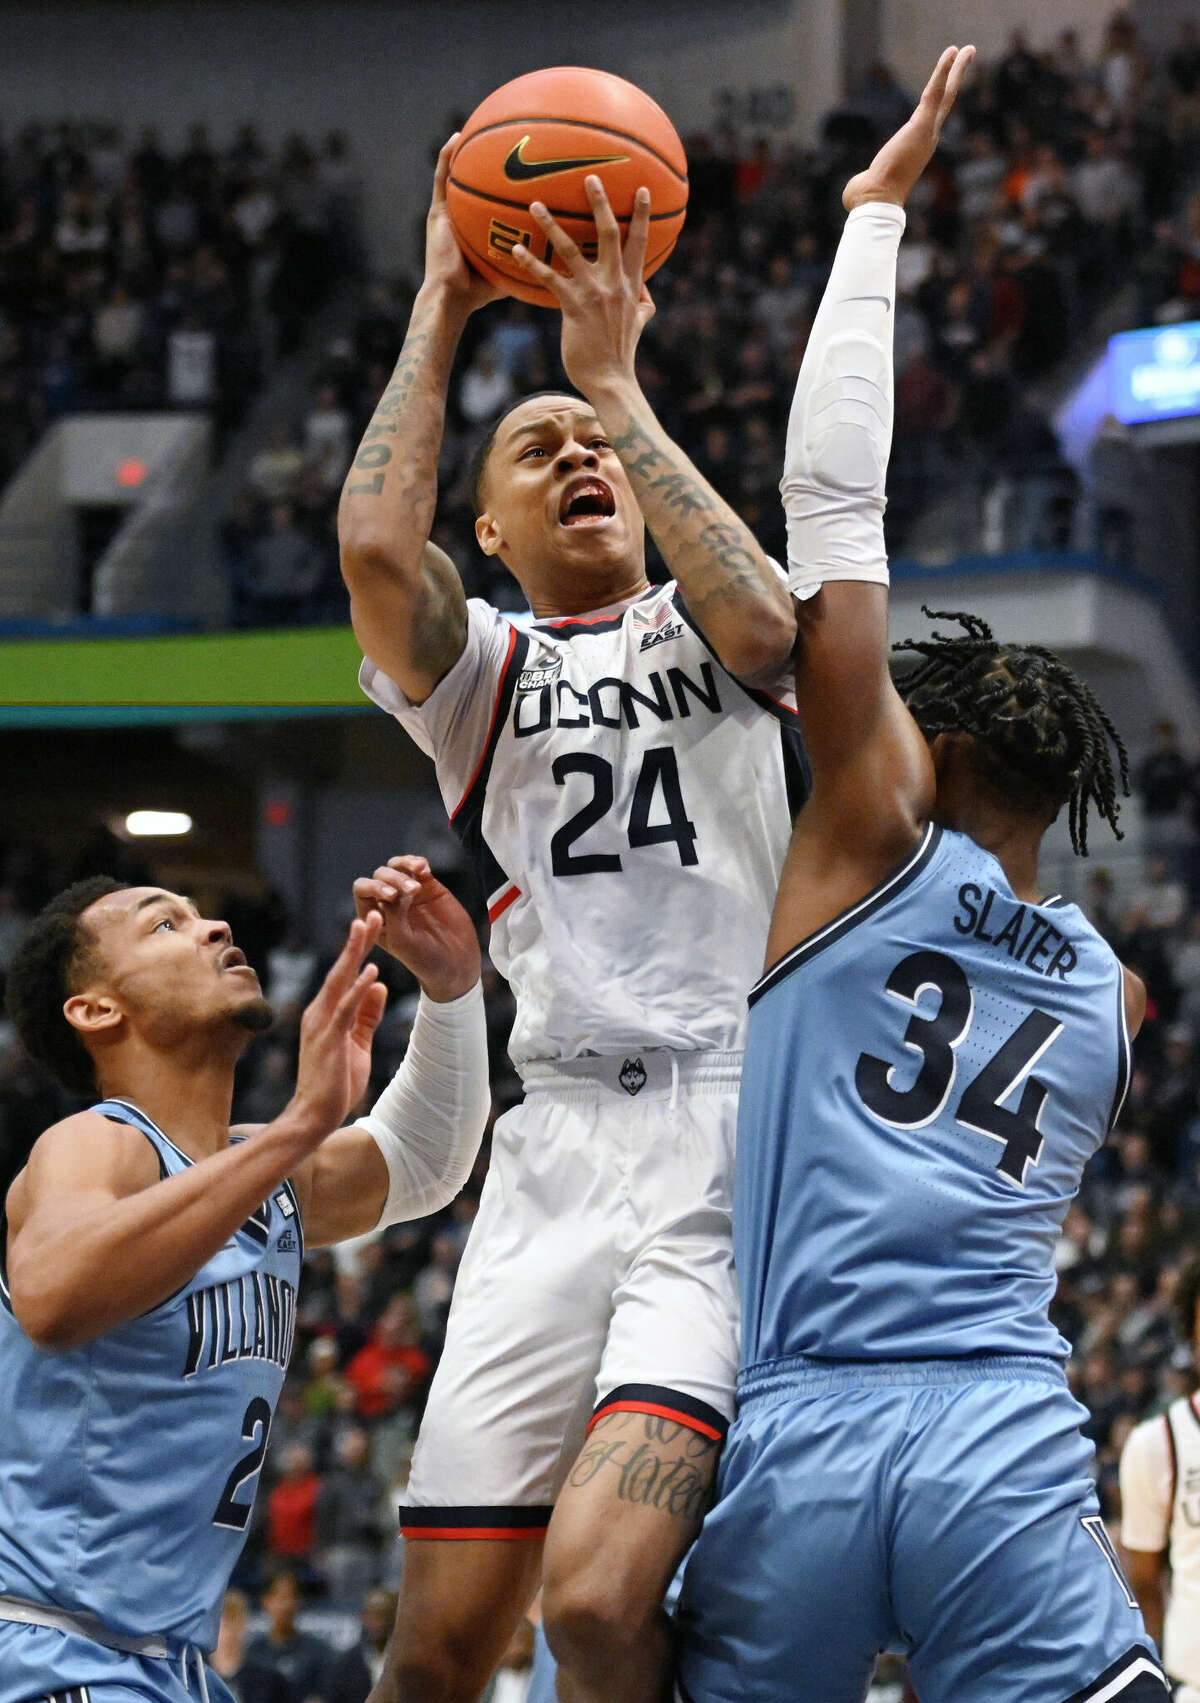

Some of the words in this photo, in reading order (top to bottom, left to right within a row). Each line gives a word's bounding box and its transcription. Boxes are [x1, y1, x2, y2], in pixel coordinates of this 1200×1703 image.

[640, 624, 684, 648] EAST
[514, 661, 723, 738] UCONN
[550, 746, 699, 877] 24
[954, 883, 1078, 982] SLATER
[854, 950, 1065, 1190] 34
[183, 1270, 296, 1382] VILLANO
[212, 1396, 273, 1532] 2
